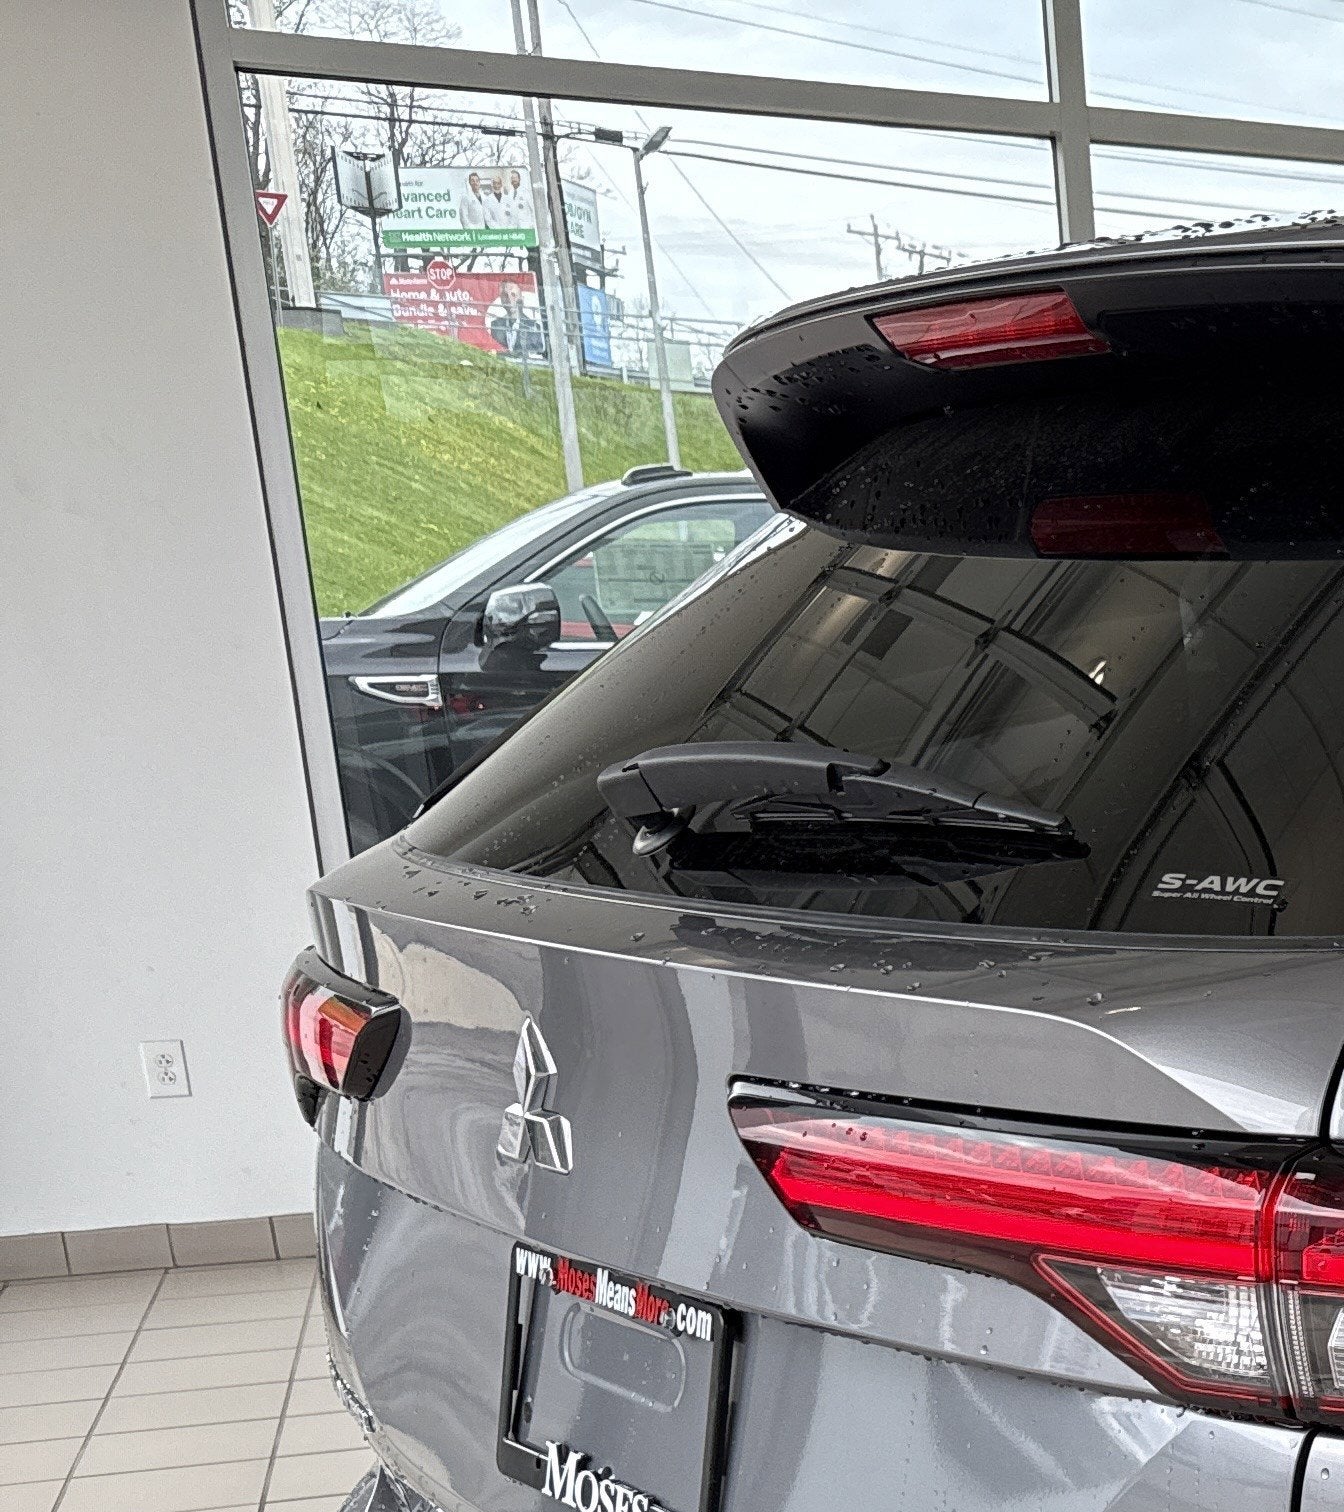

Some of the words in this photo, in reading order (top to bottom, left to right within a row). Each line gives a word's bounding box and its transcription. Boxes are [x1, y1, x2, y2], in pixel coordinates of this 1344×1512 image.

[402, 189, 451, 202] vanced
[425, 206, 457, 219] Care
[429, 268, 453, 280] STOP
[1157, 873, 1285, 896] S-AWC
[1152, 890, 1183, 898] Super
[1200, 892, 1233, 901] Wheel
[1233, 895, 1274, 904] Control
[515, 1247, 713, 1341] www.MosesMeansMorecom
